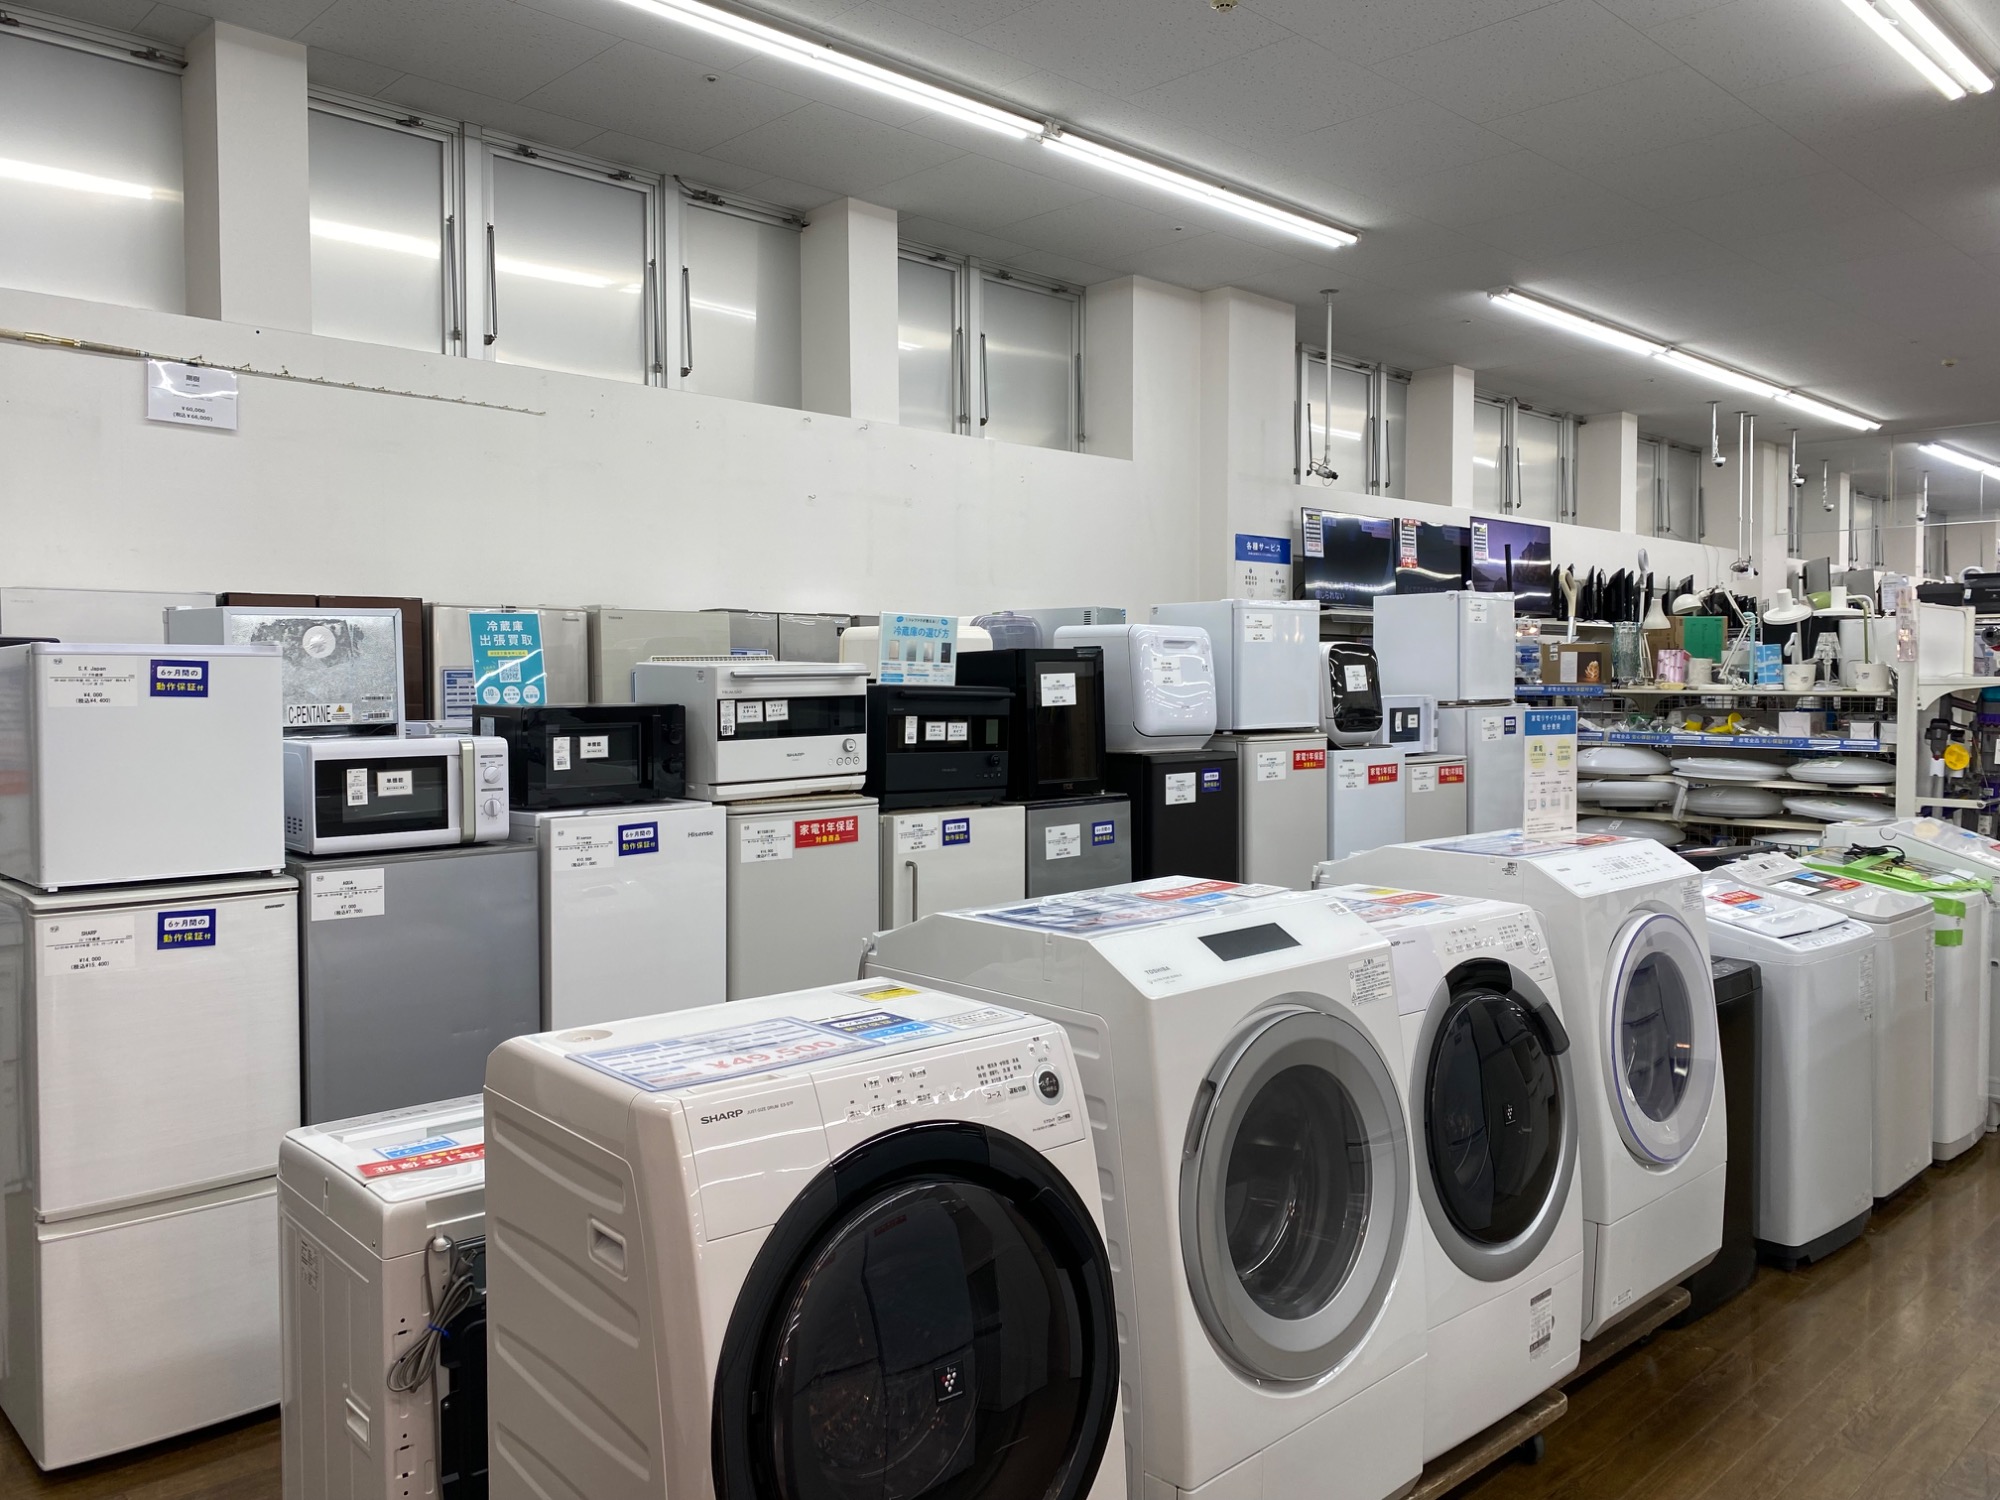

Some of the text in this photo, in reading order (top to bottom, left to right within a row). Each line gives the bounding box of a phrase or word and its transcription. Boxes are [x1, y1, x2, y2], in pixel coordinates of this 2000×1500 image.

[1246, 541, 1281, 553] 各種サービス
[486, 620, 524, 632] 冷蔵庫
[893, 625, 950, 639] 冷蔵庫の選び方
[479, 634, 533, 646] 出張買取
[160, 669, 199, 678] 6ヶ月間の
[156, 682, 204, 692] 動作保証付
[288, 704, 331, 724] C-PENTANE
[687, 829, 714, 838] Hisense
[799, 819, 855, 836] 家電1年保証
[624, 829, 652, 839] 6ヶ月間の
[815, 834, 841, 843] 対象商品
[168, 918, 206, 929] 6ヶ月間の
[163, 931, 212, 943] 動作保証付
[1144, 965, 1171, 975] TOSHIBA
[704, 1039, 837, 1072] ¥49,500
[986, 1090, 1002, 1099] コース
[700, 1108, 744, 1125] SHARP
[746, 1106, 767, 1115] JUST-SIZE
[373, 1149, 486, 1175] 電1年保証
